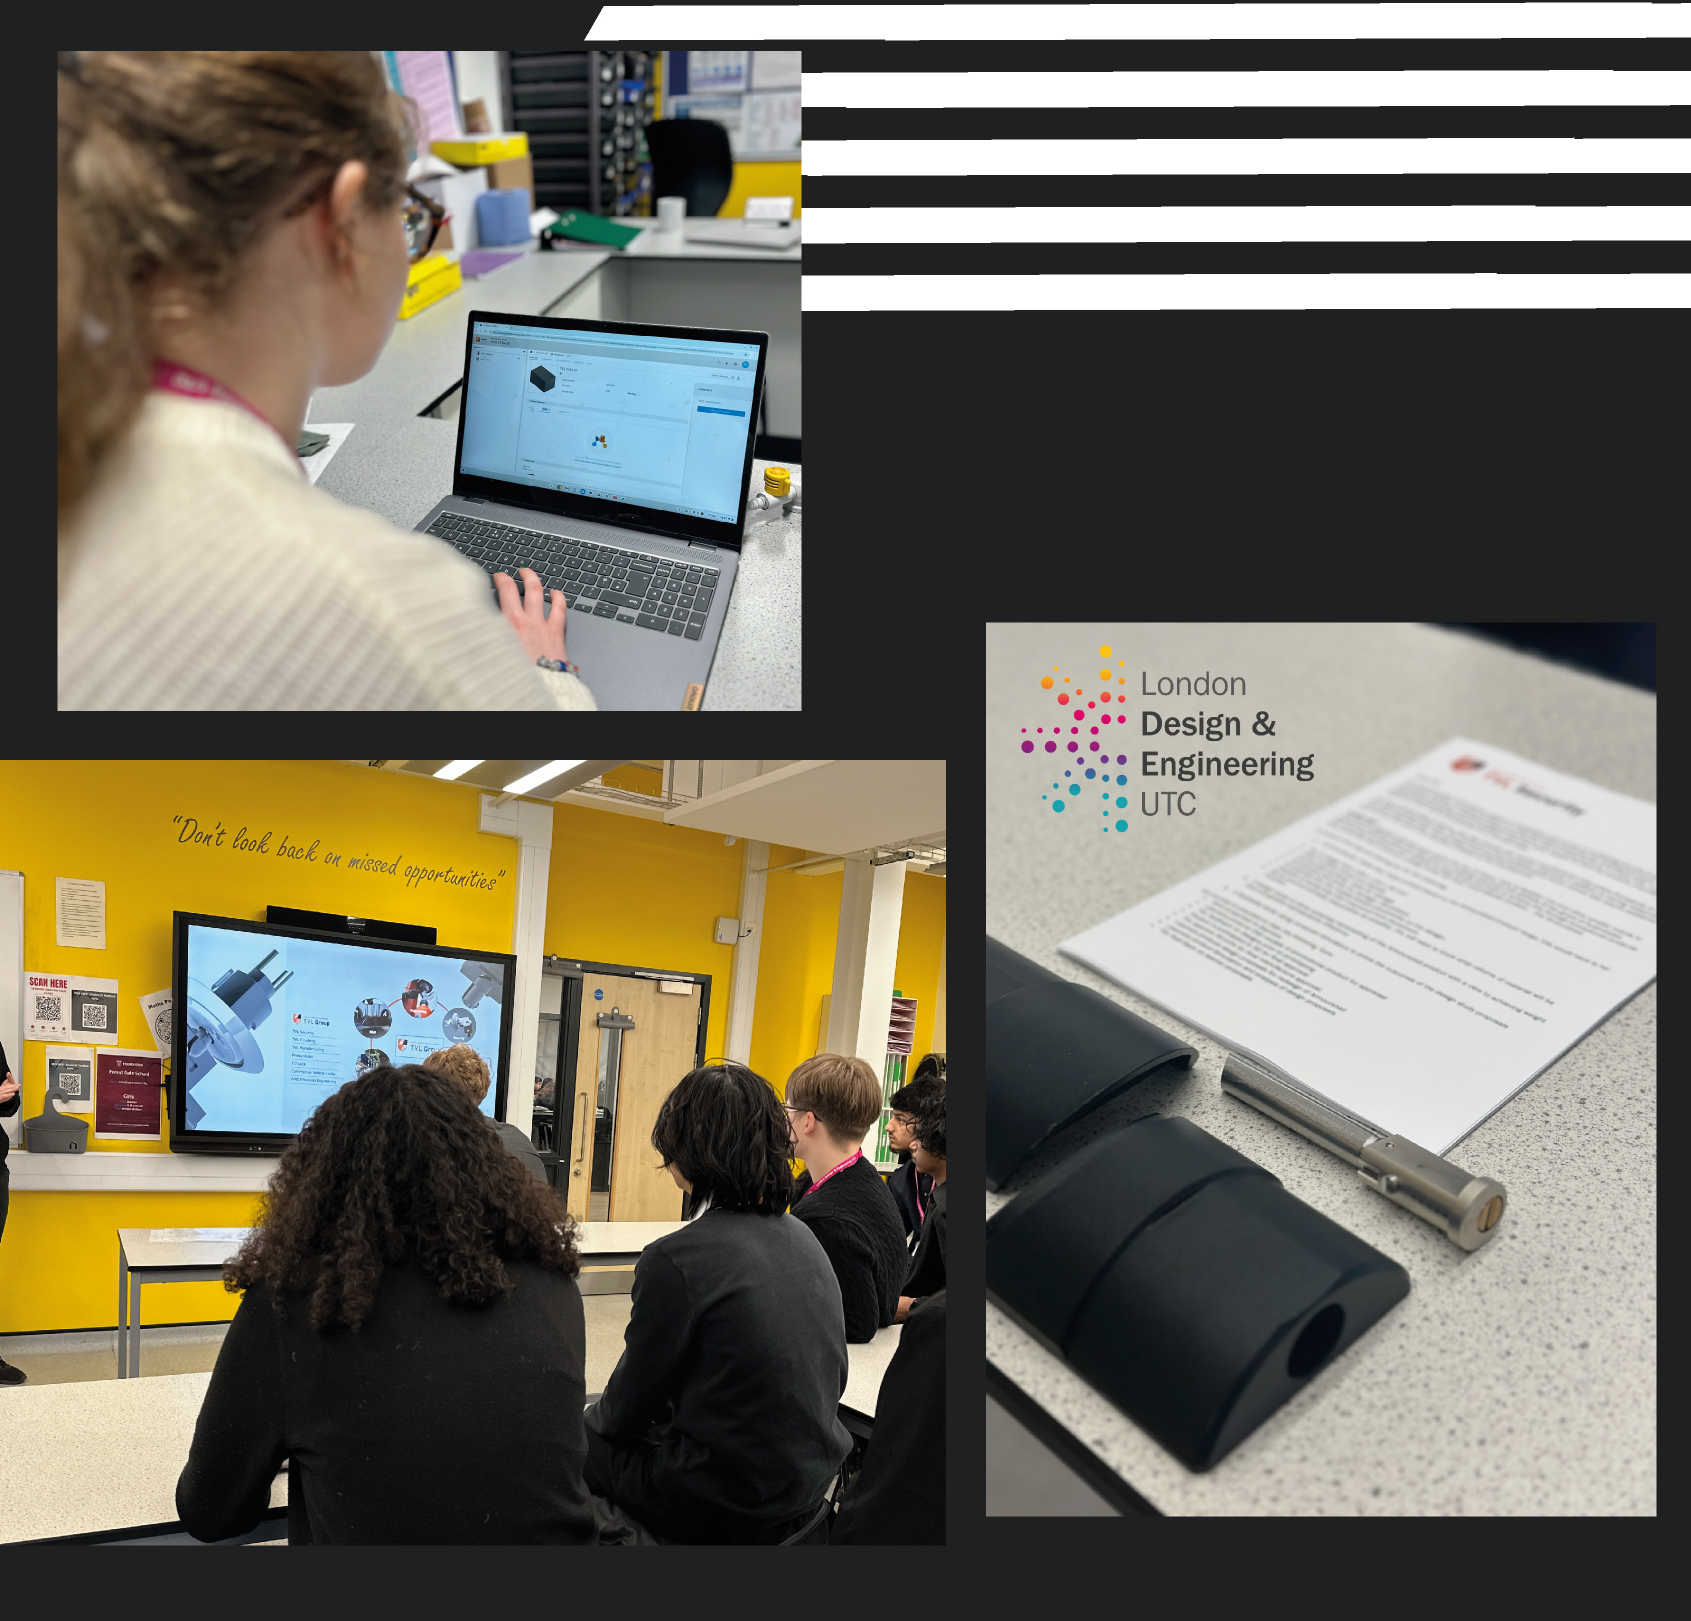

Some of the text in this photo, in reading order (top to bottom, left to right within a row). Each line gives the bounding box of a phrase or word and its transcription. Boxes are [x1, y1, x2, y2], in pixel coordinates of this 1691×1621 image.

[232, 826, 273, 855] look
[276, 835, 321, 862] back
[324, 851, 342, 867] on
[347, 852, 403, 876] missed
[29, 976, 68, 989] SCAN HERE
[315, 1019, 330, 1027] Group
[410, 1044, 422, 1052] TVL
